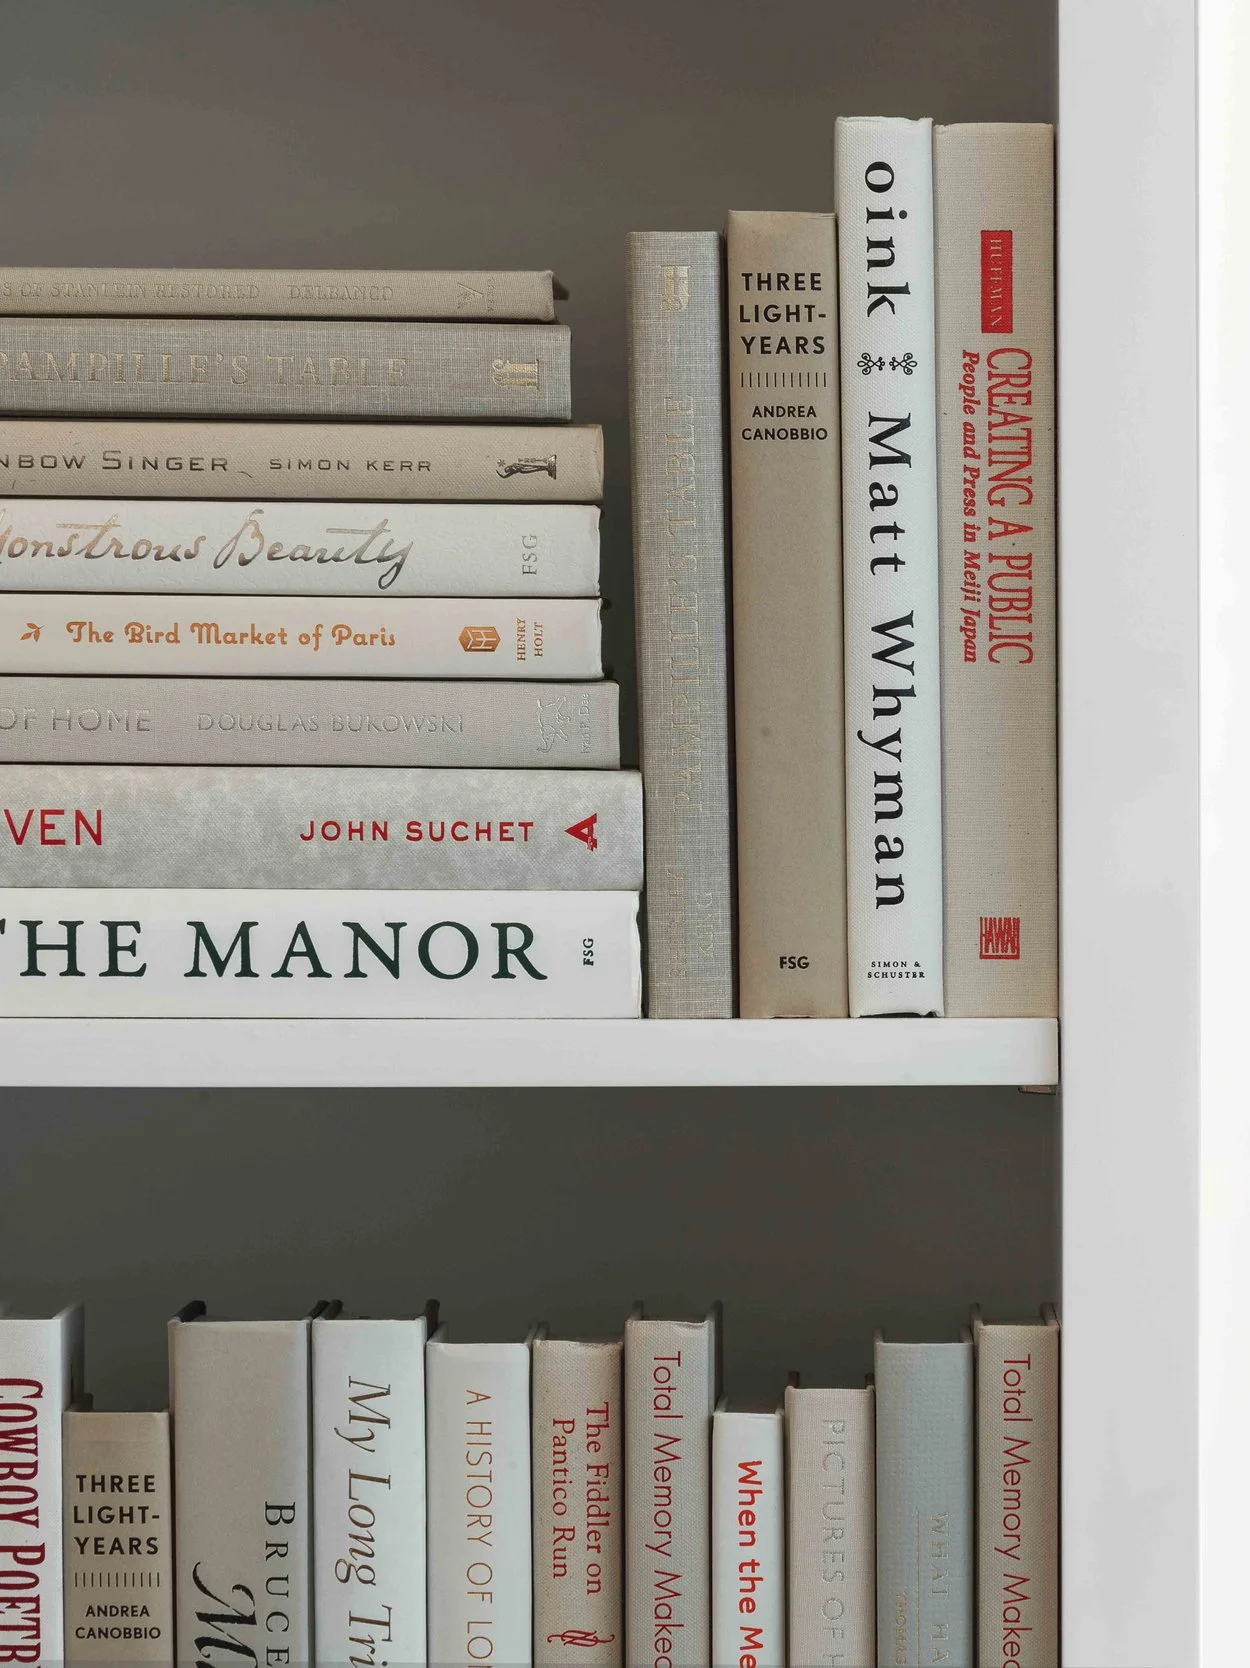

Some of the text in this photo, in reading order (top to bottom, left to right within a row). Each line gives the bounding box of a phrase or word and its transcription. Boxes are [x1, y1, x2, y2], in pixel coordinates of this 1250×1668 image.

[865, 162, 910, 317] oink
[742, 273, 821, 291] THREE
[986, 239, 1003, 328] HUFFMAN
[740, 305, 826, 322] LIGHT-
[741, 336, 824, 354] YEARS
[267, 355, 409, 388] TABLE
[742, 428, 827, 440] CANOBBIO
[752, 406, 816, 417] ANDREA
[102, 451, 227, 471] SINGER
[270, 459, 430, 471] SIMON KERR
[959, 350, 981, 663] People and Press in Meiji Japan
[987, 348, 1033, 664] CREATING A PUBLIC
[213, 509, 413, 590] Beauty
[522, 535, 537, 575] FSG
[665, 396, 702, 813] PAMPILLE'S TABLE
[66, 622, 395, 651] The Bird Market of Paris
[517, 619, 525, 661] HENRY
[534, 625, 543, 656] HOLT
[857, 412, 916, 909] Matt Whyman
[0, 706, 151, 733] OF HOME
[197, 712, 464, 735] DOUGLAS BUKOWSKI
[4, 809, 102, 845] VEN
[300, 821, 533, 842] JOHN SUCHET
[0, 918, 547, 980] HE MANOR
[583, 938, 594, 966] FSG
[780, 956, 809, 969] FSG
[653, 1351, 683, 1418] Total
[1003, 1354, 1033, 1421] Total
[334, 1376, 390, 1452] My
[76, 1475, 155, 1492] THREE
[553, 1419, 575, 1578] Pantico Run
[587, 1401, 611, 1594] The Fiddler on
[645, 1433, 681, 1557] Memory
[738, 1461, 763, 1546] When
[820, 1418, 846, 1584] PICTURES
[994, 1437, 1031, 1560] Memory
[0, 1378, 45, 1668] COWBOY POETR
[74, 1506, 159, 1524] LIGHT-
[335, 1469, 390, 1585] Long
[466, 1390, 493, 1668] A HISTORY OF LO
[74, 1537, 158, 1555] YEARS
[930, 1511, 951, 1599] WHAT
[265, 1501, 295, 1667] BRUCE
[739, 1559, 763, 1613] the
[76, 1627, 160, 1639] CANOBBIO
[86, 1605, 149, 1617] ANDREA
[192, 1561, 258, 1668] M
[820, 1597, 845, 1641] OF
